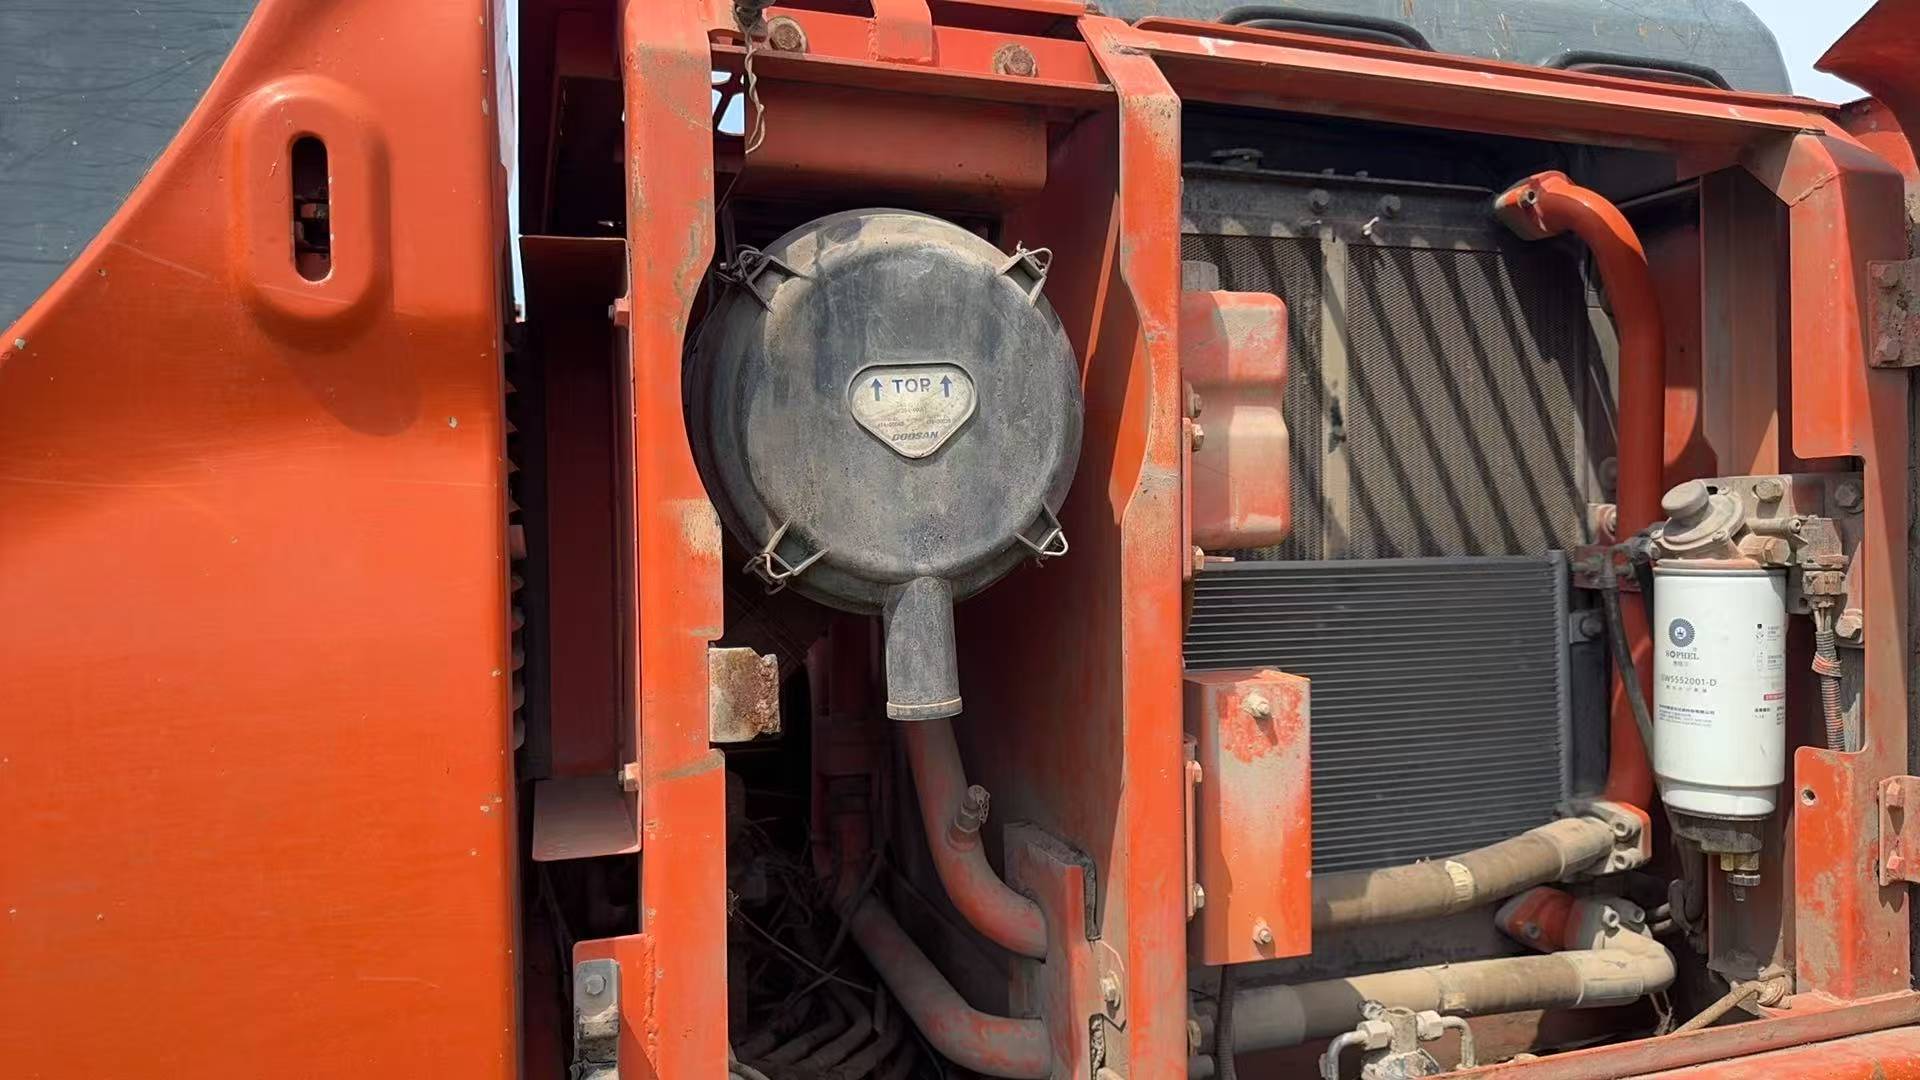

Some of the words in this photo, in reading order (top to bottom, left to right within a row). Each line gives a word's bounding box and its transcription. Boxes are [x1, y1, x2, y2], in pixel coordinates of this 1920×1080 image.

[891, 378, 931, 393] TOP
[891, 431, 938, 441] DOOSAN
[1665, 650, 1700, 660] SOPHEL
